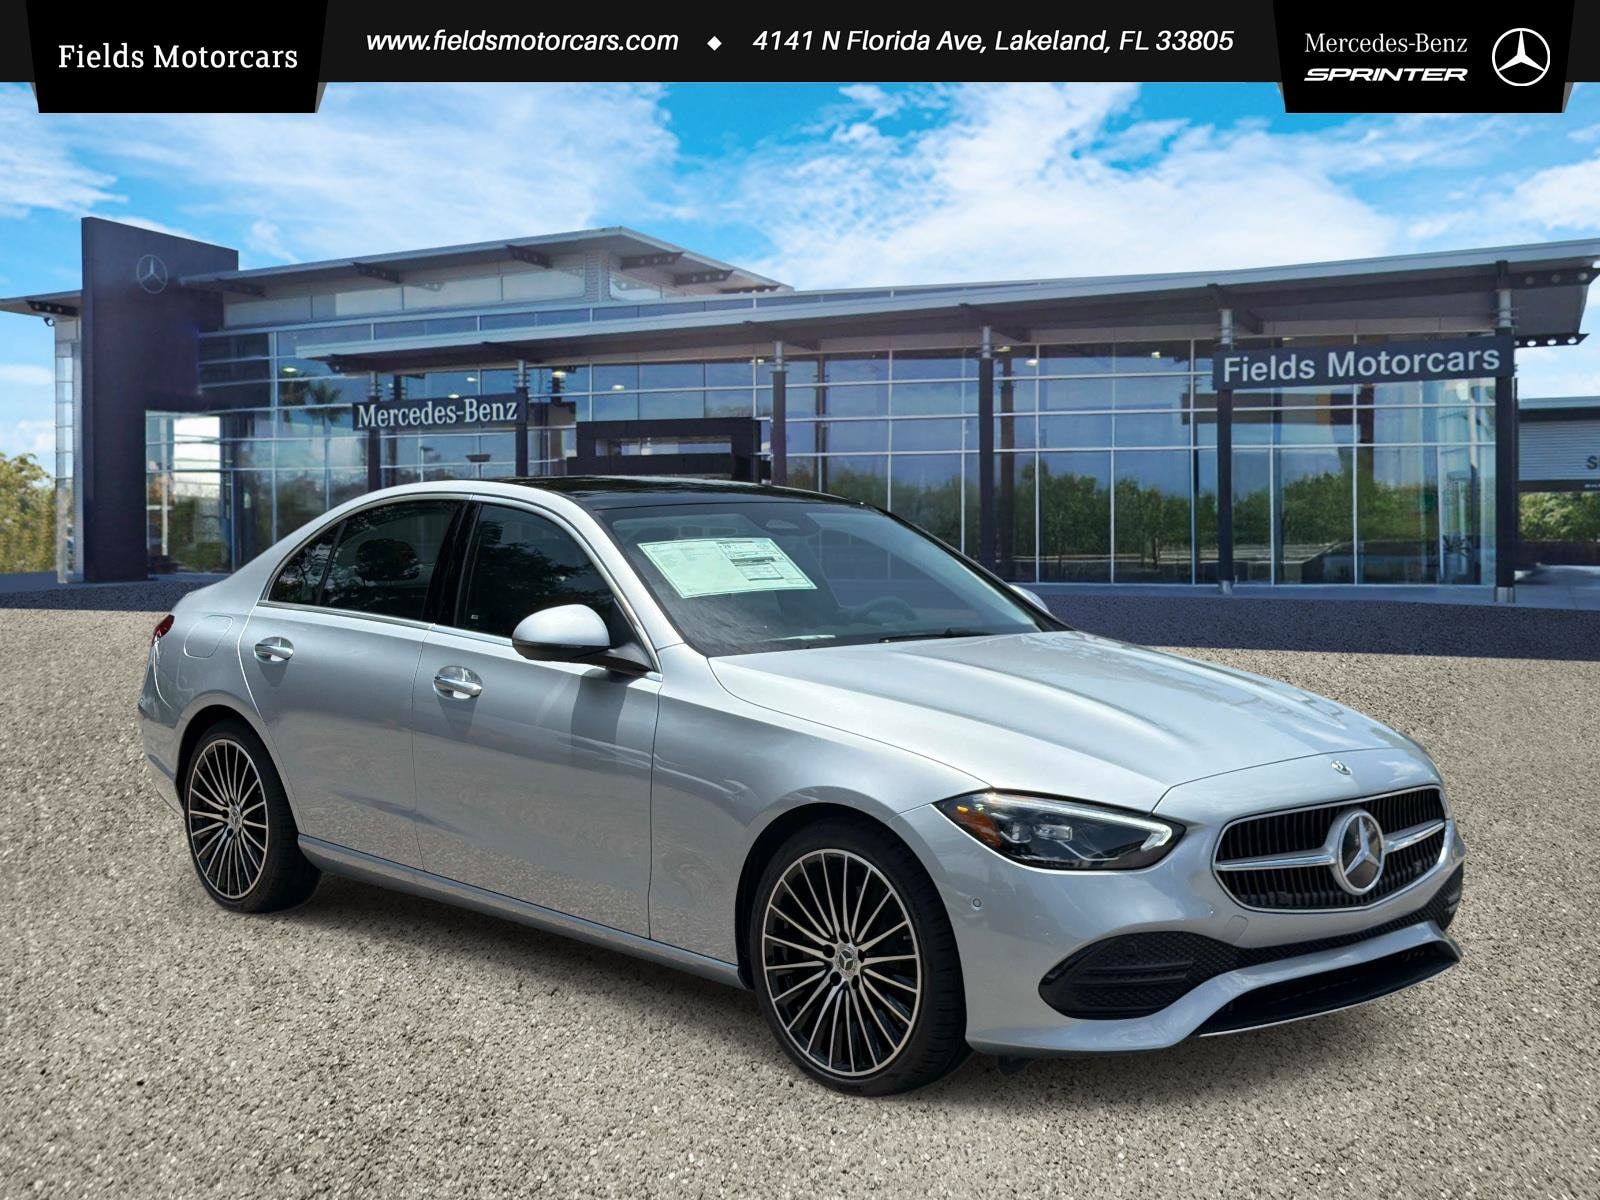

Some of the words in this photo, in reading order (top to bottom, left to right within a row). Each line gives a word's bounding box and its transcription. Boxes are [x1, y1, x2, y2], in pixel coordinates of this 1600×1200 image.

[1223, 354, 1316, 383] Fields
[1327, 349, 1501, 378] Motorcars
[357, 398, 518, 428] Mercedes-Benz
